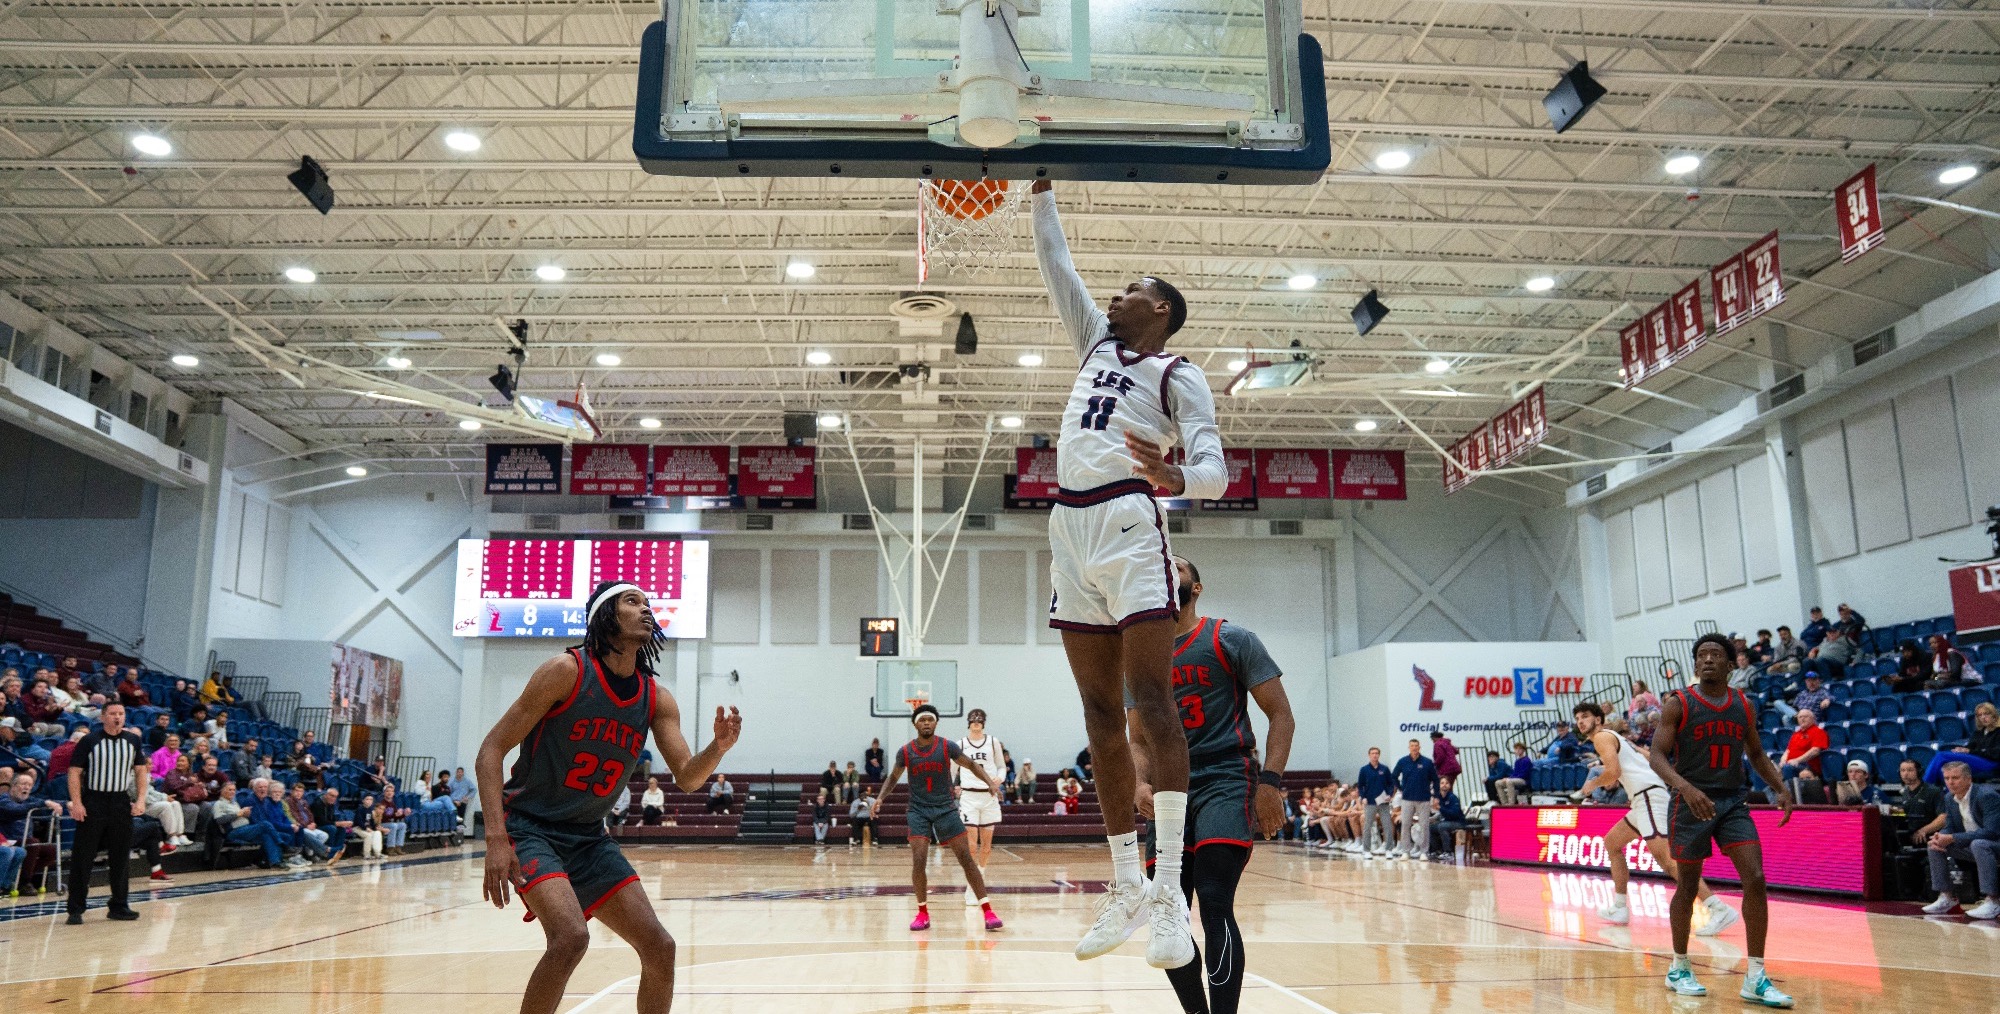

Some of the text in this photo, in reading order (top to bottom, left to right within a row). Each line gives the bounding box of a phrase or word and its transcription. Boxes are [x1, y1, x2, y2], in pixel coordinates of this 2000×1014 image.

[1847, 187, 1869, 226] 34
[1755, 251, 1774, 286] 22
[1722, 273, 1738, 304] 44
[1683, 299, 1694, 327] 5
[1654, 318, 1666, 346] 13
[1092, 370, 1136, 396] LEE
[1080, 396, 1118, 431] 11
[523, 603, 537, 626] 8
[562, 610, 587, 624] 14:1
[1171, 664, 1213, 687] ATE
[1465, 676, 1514, 696] FOOD
[1546, 676, 1584, 696] CITY
[1176, 694, 1206, 730] 3
[568, 717, 645, 760] STATE
[1400, 722, 1440, 732] Official
[1443, 722, 1514, 733] Supermarket
[1693, 720, 1744, 742] STATE
[912, 760, 944, 776] STATE
[970, 752, 988, 761] LEE
[1709, 744, 1731, 768] 11
[564, 751, 626, 798] 23
[925, 776, 933, 794] 1
[1546, 834, 1664, 873] FLOCOLEG
